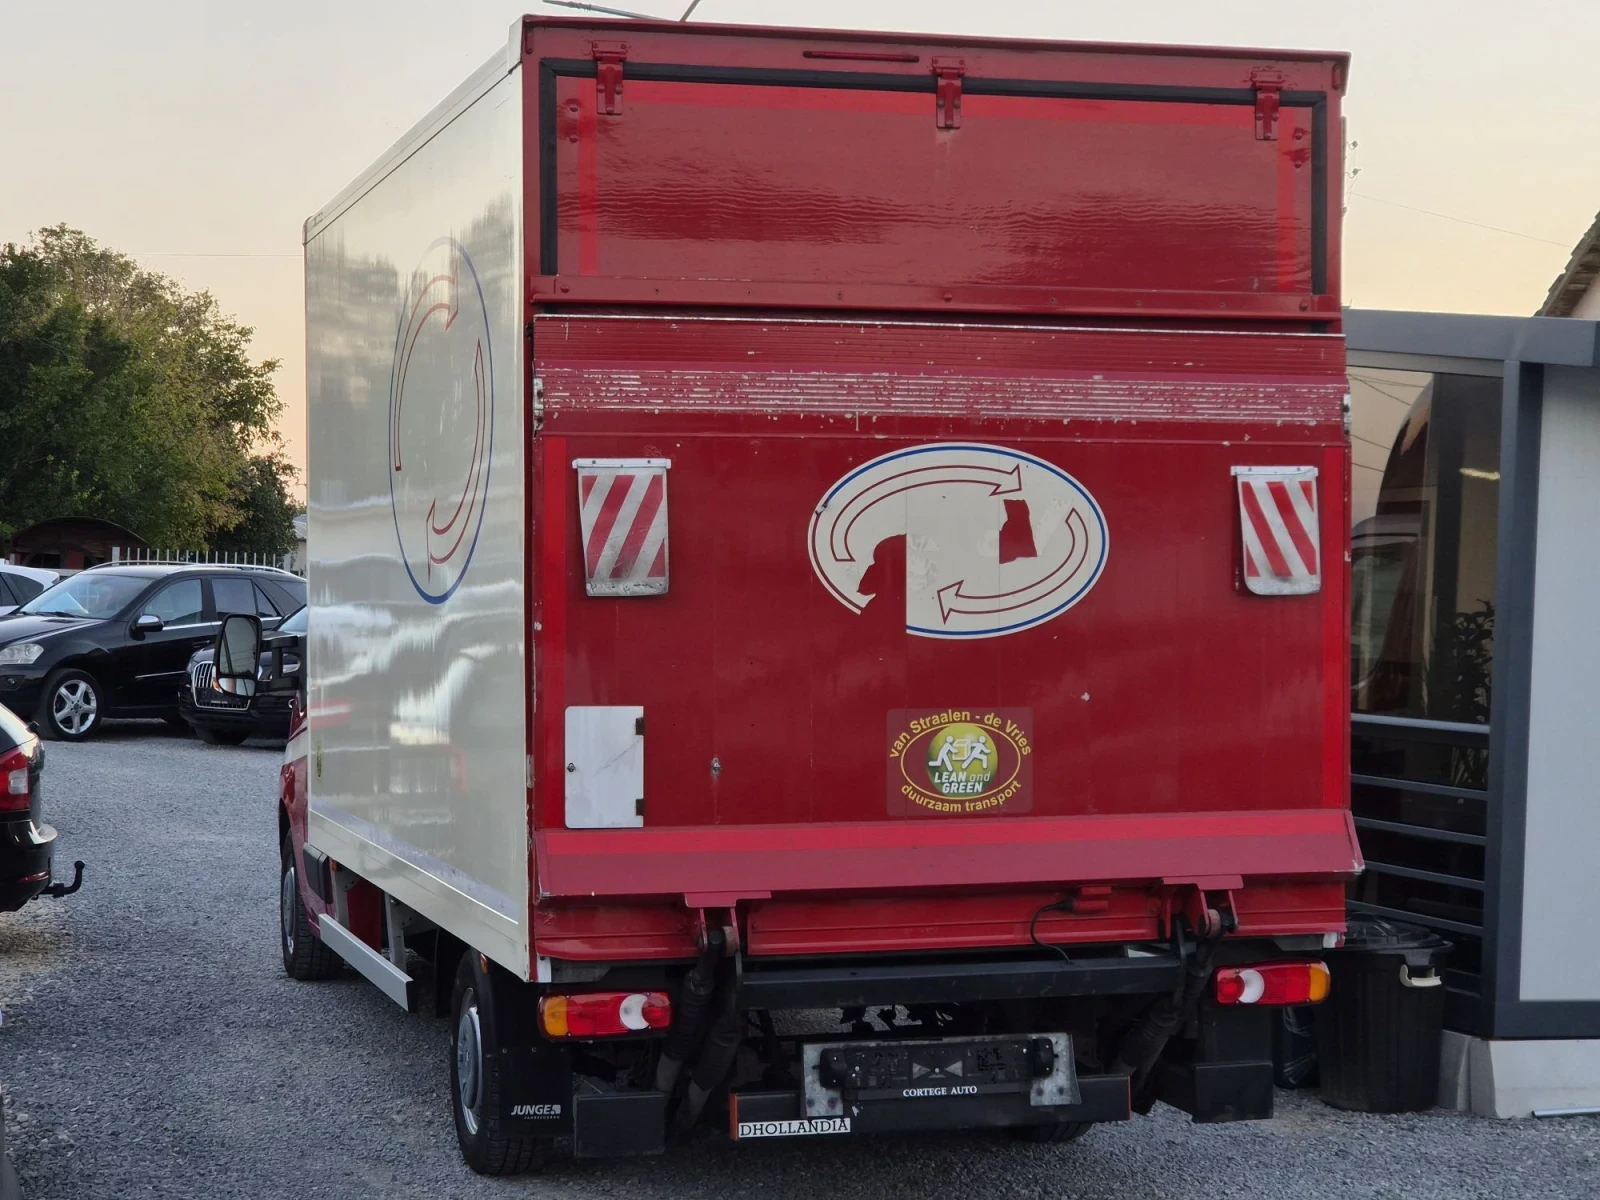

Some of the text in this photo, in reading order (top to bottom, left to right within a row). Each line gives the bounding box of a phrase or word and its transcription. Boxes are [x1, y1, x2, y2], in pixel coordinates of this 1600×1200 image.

[889, 732, 911, 759] van
[909, 709, 970, 734] Straalen
[984, 712, 1002, 728] de
[1005, 719, 1031, 756] Vries
[934, 771, 991, 783] LEAN and
[942, 782, 983, 793] GREEN
[901, 780, 1022, 812] duurzaam transport
[902, 1085, 978, 1097] CORTEGE AUTO
[510, 1104, 552, 1116] JUNGE
[740, 1119, 849, 1136] DHOLLANDIA
